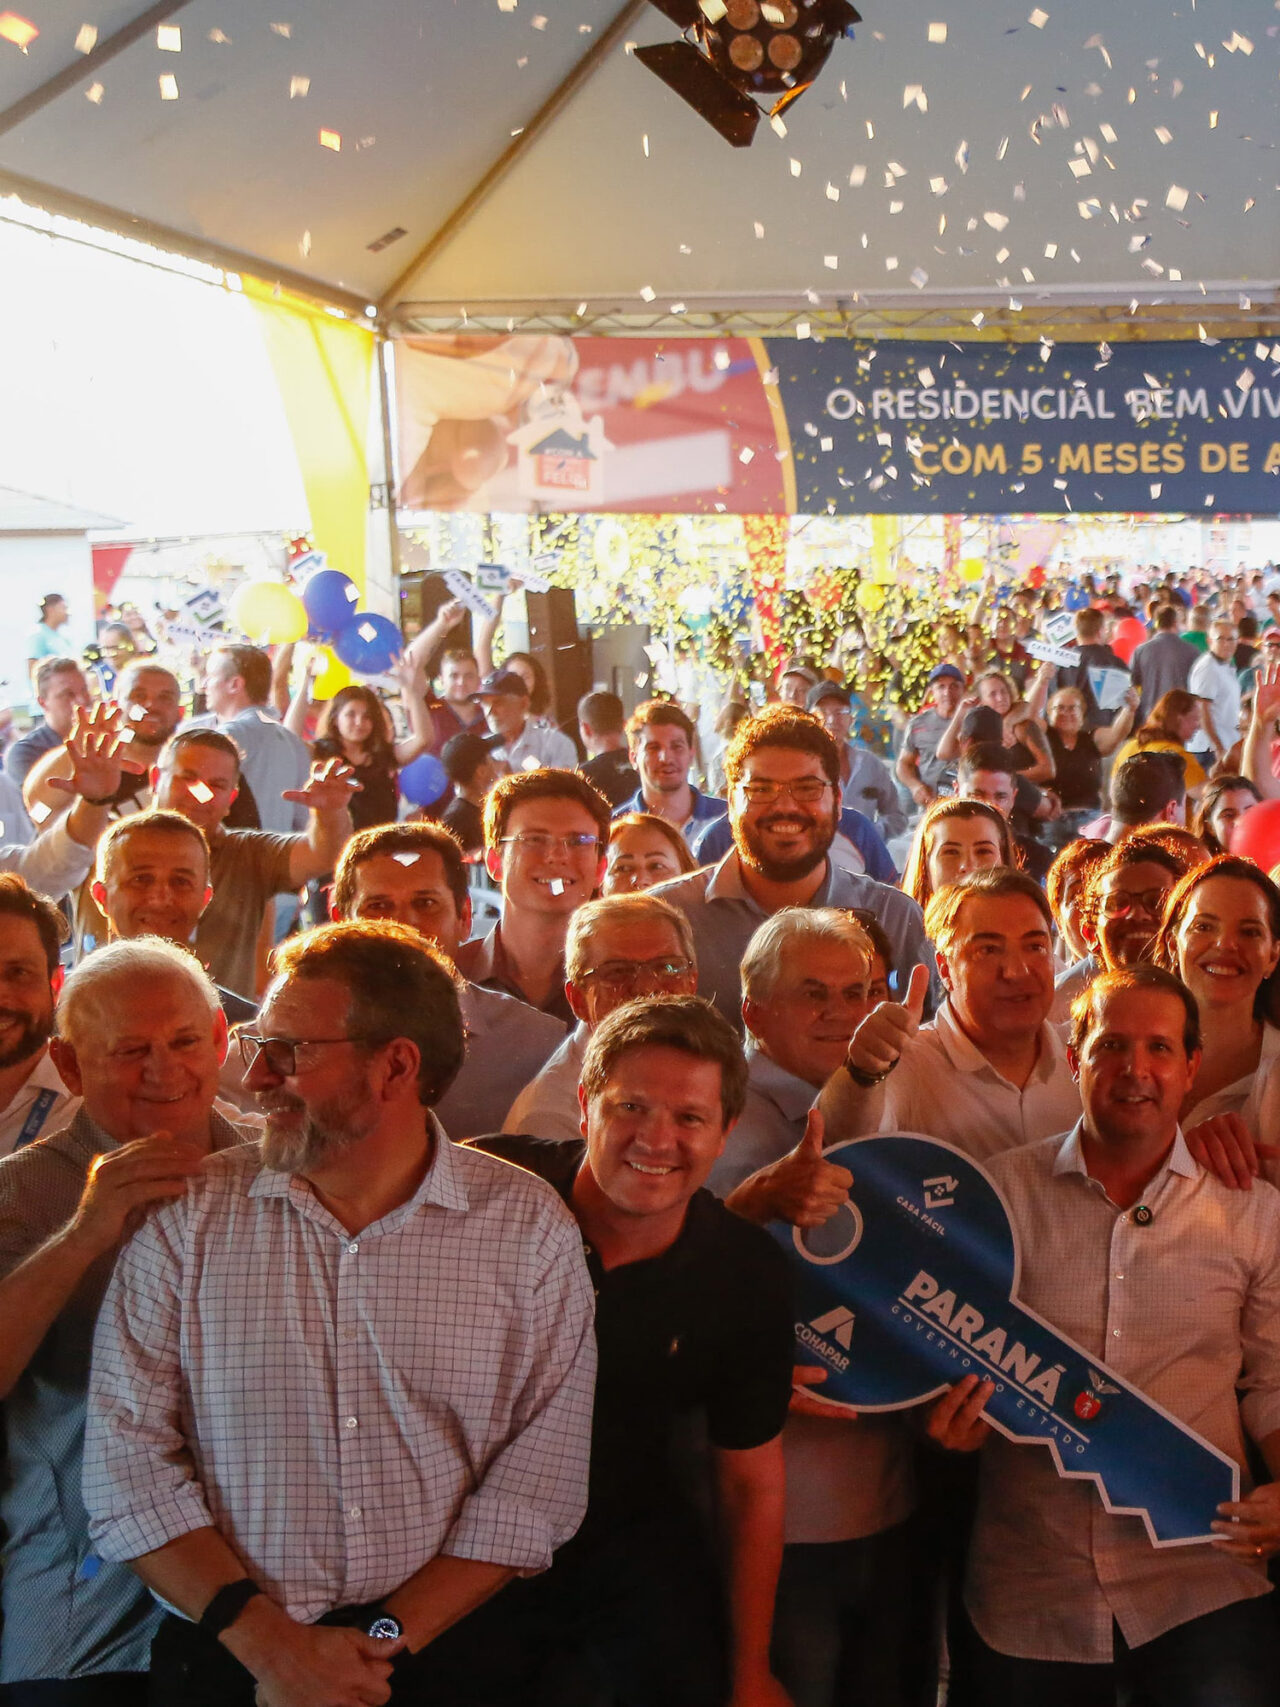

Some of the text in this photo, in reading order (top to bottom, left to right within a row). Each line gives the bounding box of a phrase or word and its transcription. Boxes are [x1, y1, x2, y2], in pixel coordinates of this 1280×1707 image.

[826, 388, 858, 420] O
[872, 388, 1116, 420] RESIDENCIAL
[1130, 387, 1209, 419] BEM
[914, 443, 1007, 475] COM
[1021, 443, 1043, 475] 5
[1058, 442, 1186, 475] MESES
[1200, 442, 1249, 473] DE
[896, 1196, 920, 1216] CASA
[793, 1322, 851, 1371] COHAPAR
[903, 1269, 1067, 1407] PARANÁ
[891, 1305, 971, 1367] GOVERNO
[1015, 1399, 1085, 1453] ESTADO
